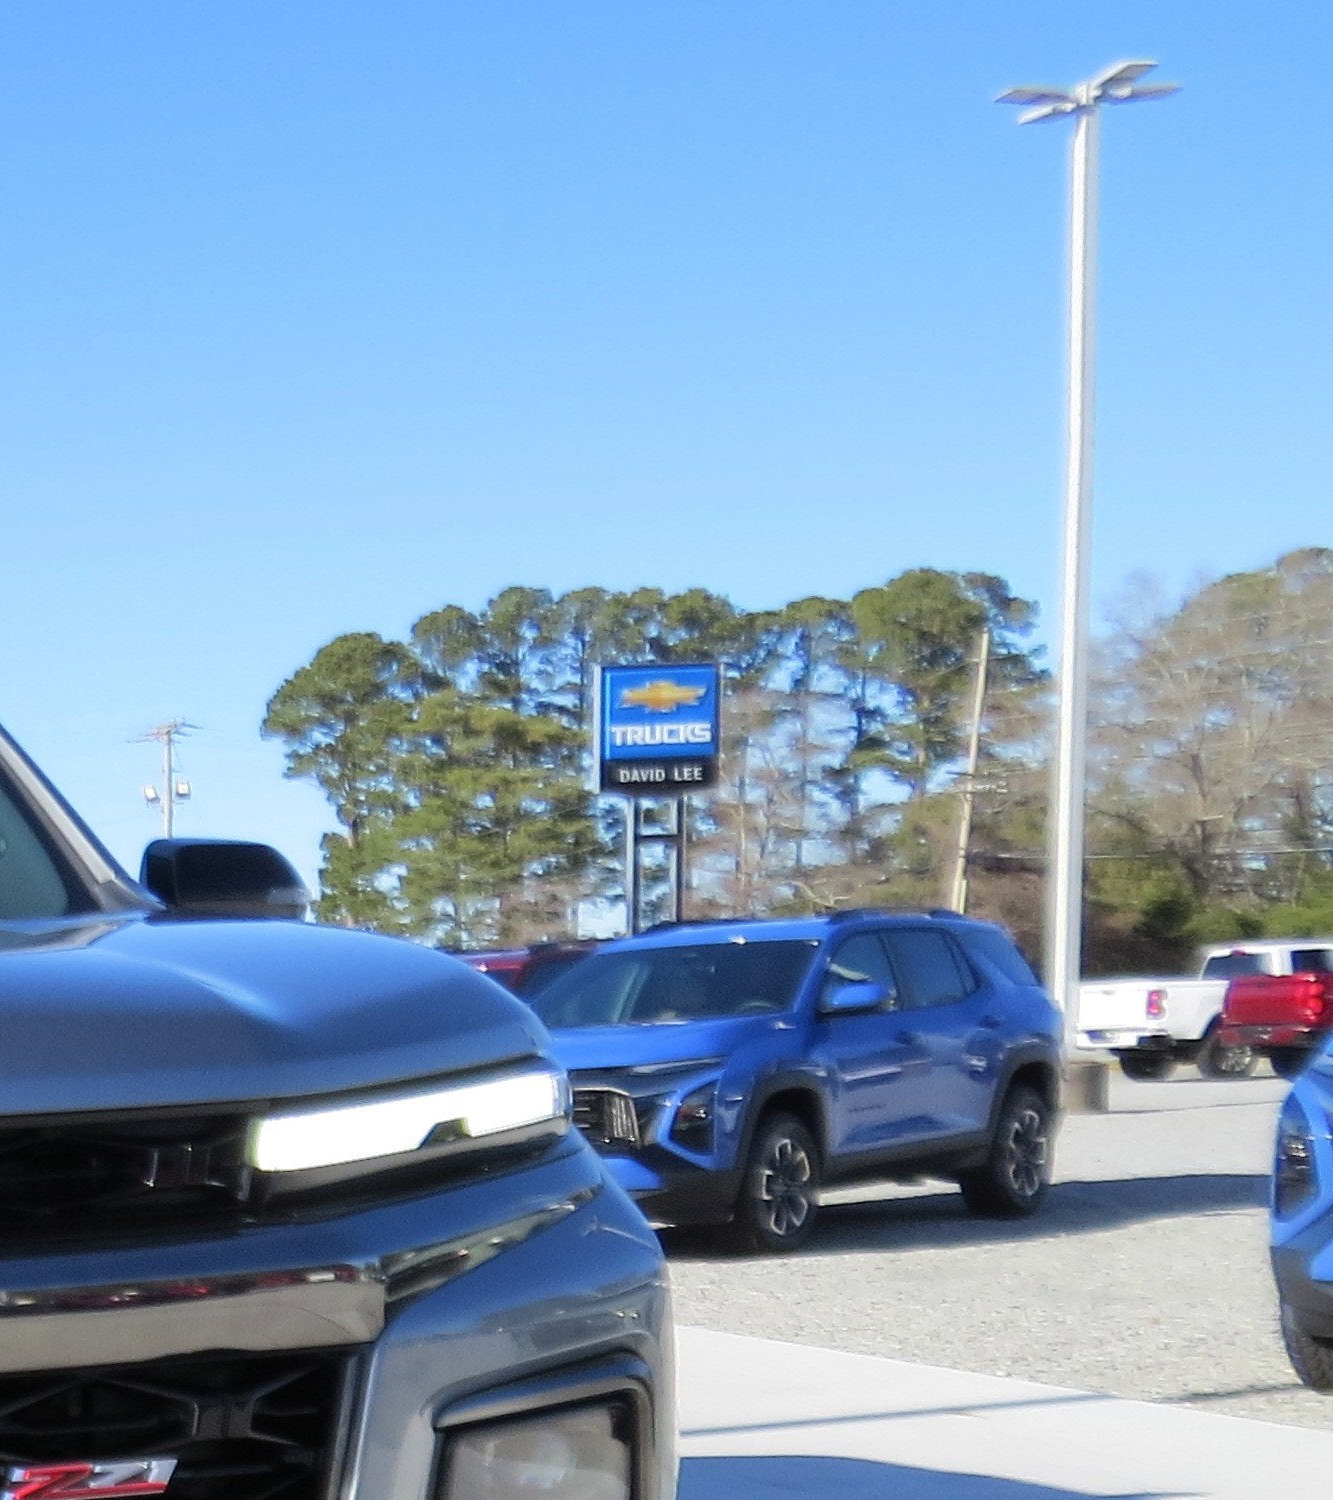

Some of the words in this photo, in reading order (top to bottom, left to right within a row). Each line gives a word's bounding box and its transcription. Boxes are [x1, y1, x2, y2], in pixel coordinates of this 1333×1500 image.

[611, 722, 713, 747] TRUCKS
[618, 768, 667, 783] DAVID
[673, 766, 703, 782] LEE
